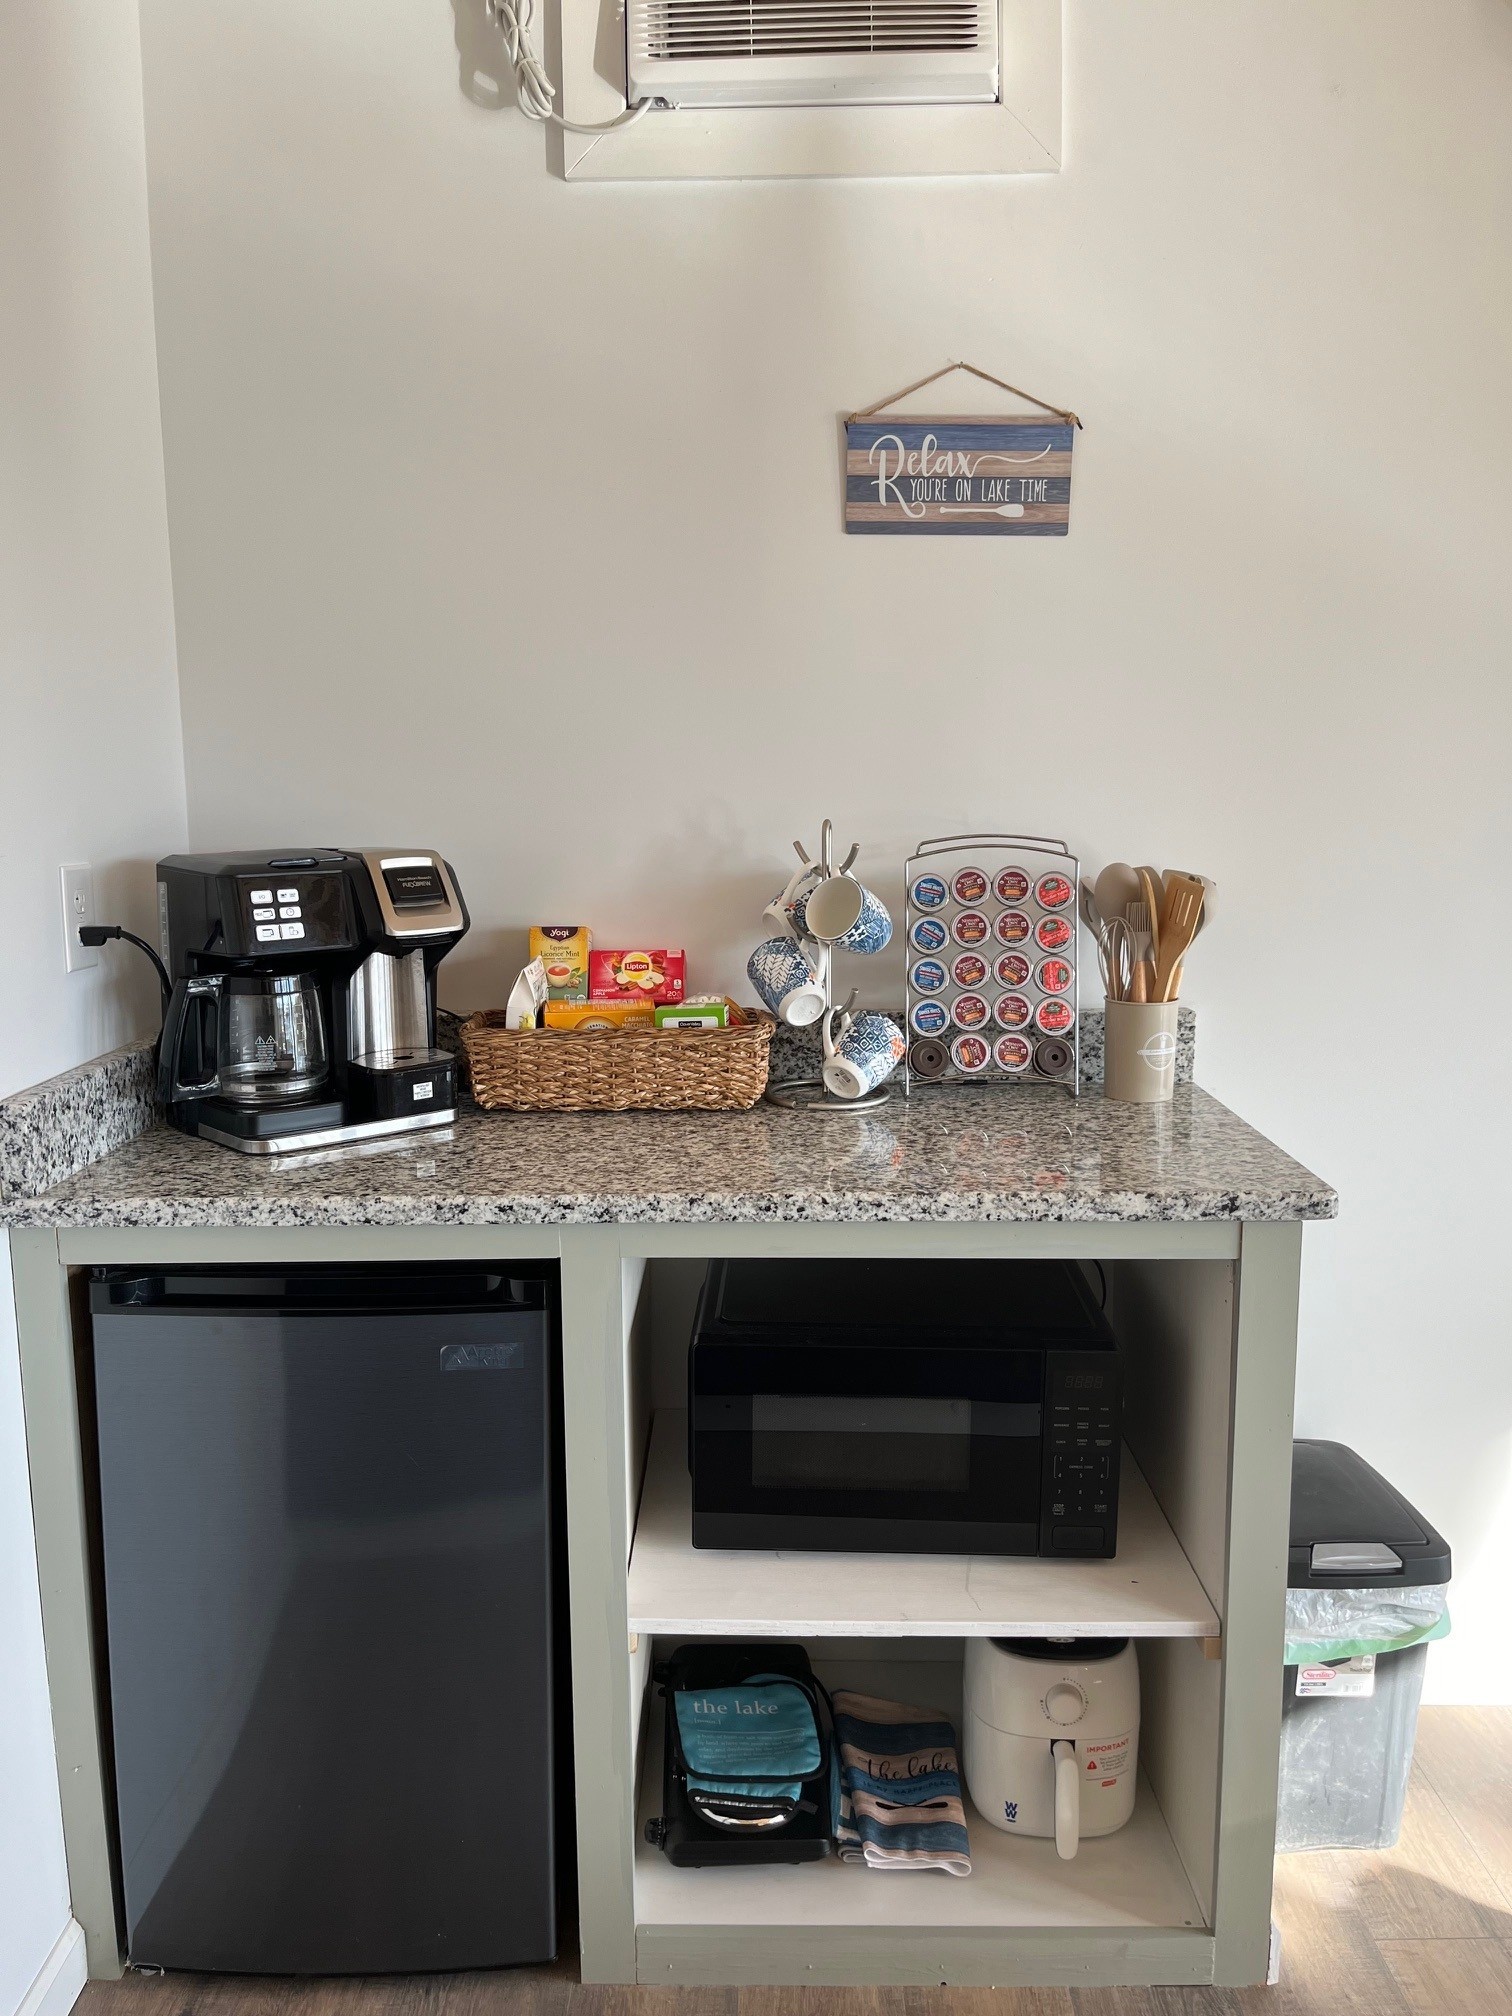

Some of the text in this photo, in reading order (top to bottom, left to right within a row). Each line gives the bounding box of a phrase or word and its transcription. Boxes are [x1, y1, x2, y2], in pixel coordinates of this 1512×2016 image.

[869, 434, 1051, 518] Relax
[910, 478, 1048, 502] YOU'RE ON LAKE TIME
[694, 1699, 778, 1714] the lake
[1086, 1738, 1129, 1753] IMPORTANT
[857, 1752, 955, 1781] the lake
